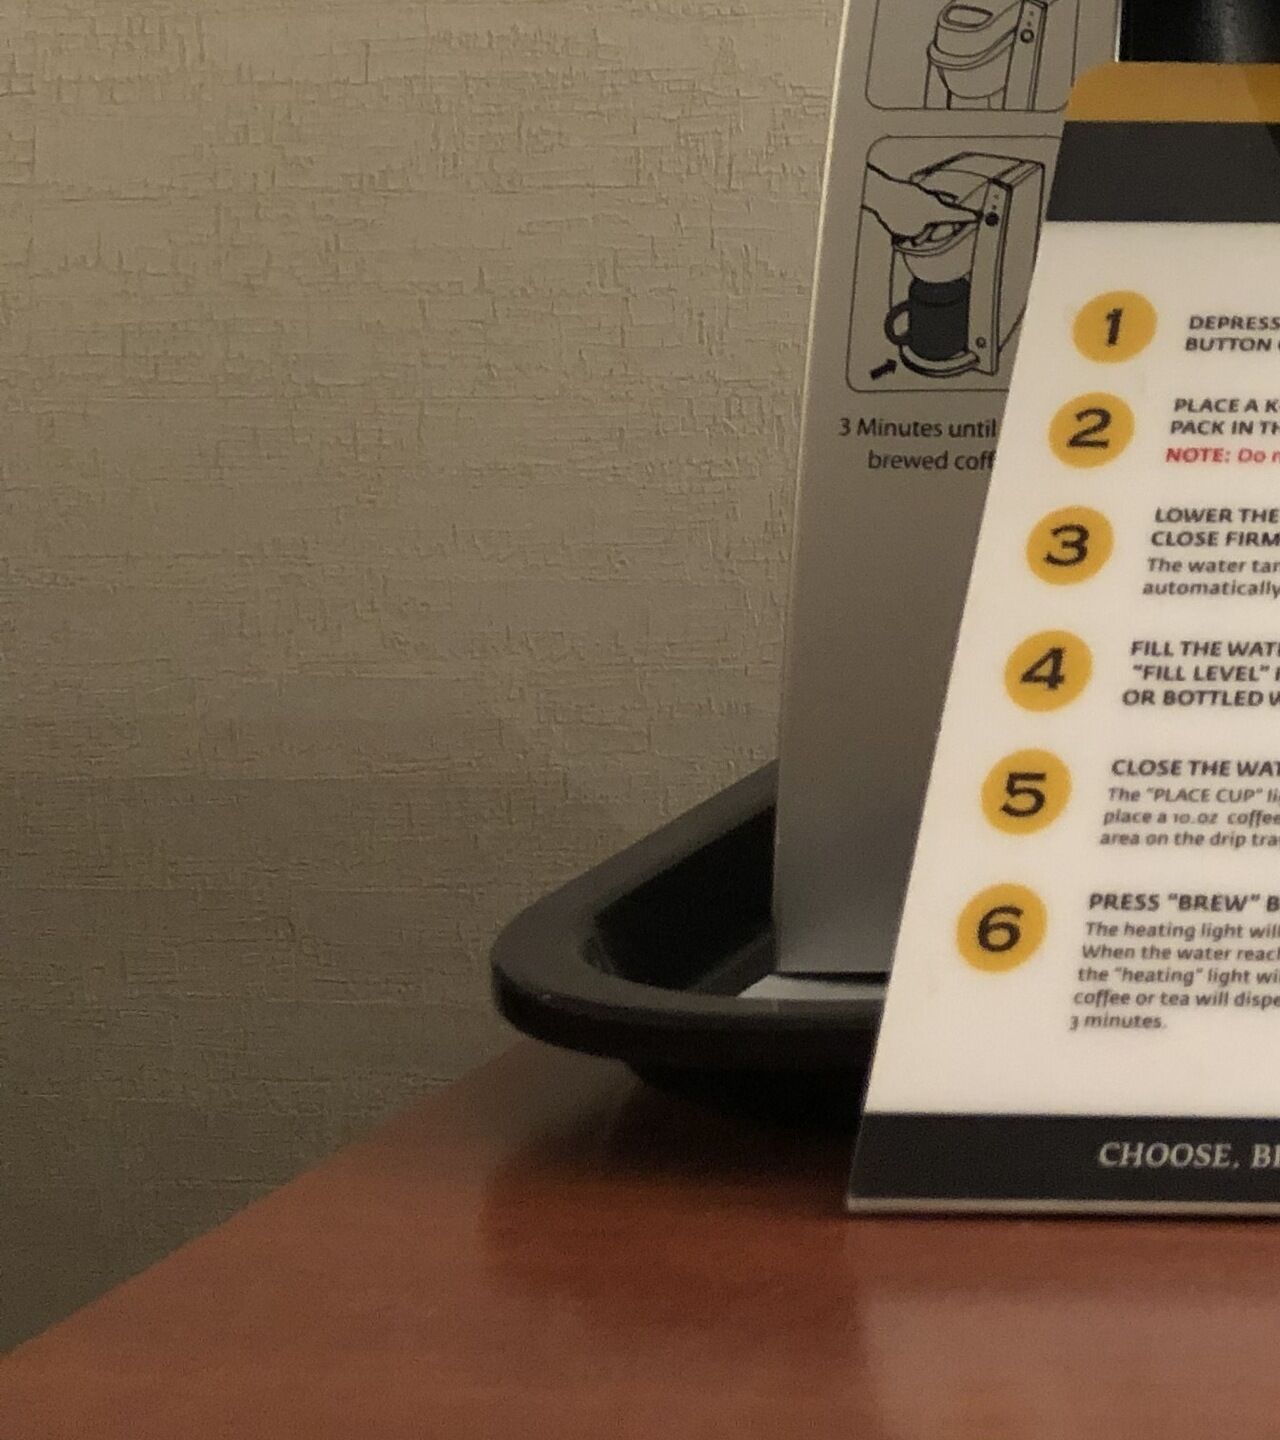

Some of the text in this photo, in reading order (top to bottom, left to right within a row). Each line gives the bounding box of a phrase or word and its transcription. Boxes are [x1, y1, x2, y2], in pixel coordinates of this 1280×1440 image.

[1106, 308, 1124, 346] 1
[1189, 316, 1280, 331] DEPRESS
[1185, 338, 1271, 352] BUTTON
[1174, 398, 1239, 413] PLACE
[1244, 398, 1258, 413] A
[838, 417, 997, 439] 3 Minutes until
[1067, 407, 1112, 450] 2
[1170, 420, 1224, 435] PACK
[1232, 421, 1252, 435] IN
[868, 449, 949, 471] brewed
[1166, 448, 1231, 463] NOTE:
[1238, 449, 1266, 463] Do
[1154, 507, 1232, 524] LOWER
[1239, 508, 1280, 524] THE
[1043, 523, 1090, 567] 3
[1151, 531, 1218, 547] CLOSE
[1147, 557, 1182, 573] The
[1188, 559, 1246, 574] water
[1130, 640, 1173, 656] FILL
[1181, 641, 1221, 656] THE
[1021, 646, 1067, 691] 4
[1133, 665, 1186, 681] "FILL
[1193, 665, 1269, 681] LEVEL"
[1122, 690, 1155, 706] OR
[1163, 690, 1263, 706] BOTTLED
[1111, 760, 1181, 777] CLOSE
[1188, 760, 1230, 777] THE
[1001, 772, 1047, 817] 5
[1108, 787, 1140, 802] The
[1146, 787, 1210, 803] "PLACE
[1216, 787, 1262, 803] CUP"
[1103, 810, 1152, 827] place
[1157, 813, 1167, 824] a
[1099, 833, 1139, 846] area
[1146, 834, 1169, 846] on
[1174, 831, 1204, 846] the
[1210, 832, 1246, 848] drip
[1089, 893, 1160, 911] PRESS
[1168, 894, 1260, 912] "BREW"
[977, 905, 1024, 953] 6
[1086, 922, 1118, 937] The
[1124, 922, 1195, 941] heating
[1201, 923, 1243, 941] light
[1082, 945, 1135, 960] When
[1141, 946, 1171, 960] the
[1177, 947, 1230, 961] water
[1078, 968, 1108, 983] the
[1115, 968, 1203, 986] "heating"
[1208, 969, 1249, 986] light
[1074, 990, 1130, 1007] coffee
[1135, 993, 1153, 1005] or
[1160, 992, 1189, 1006] tea
[1196, 991, 1228, 1006] will
[1070, 1013, 1166, 1031] 3 minutes.
[1100, 1142, 1239, 1169] CHOOSE.
